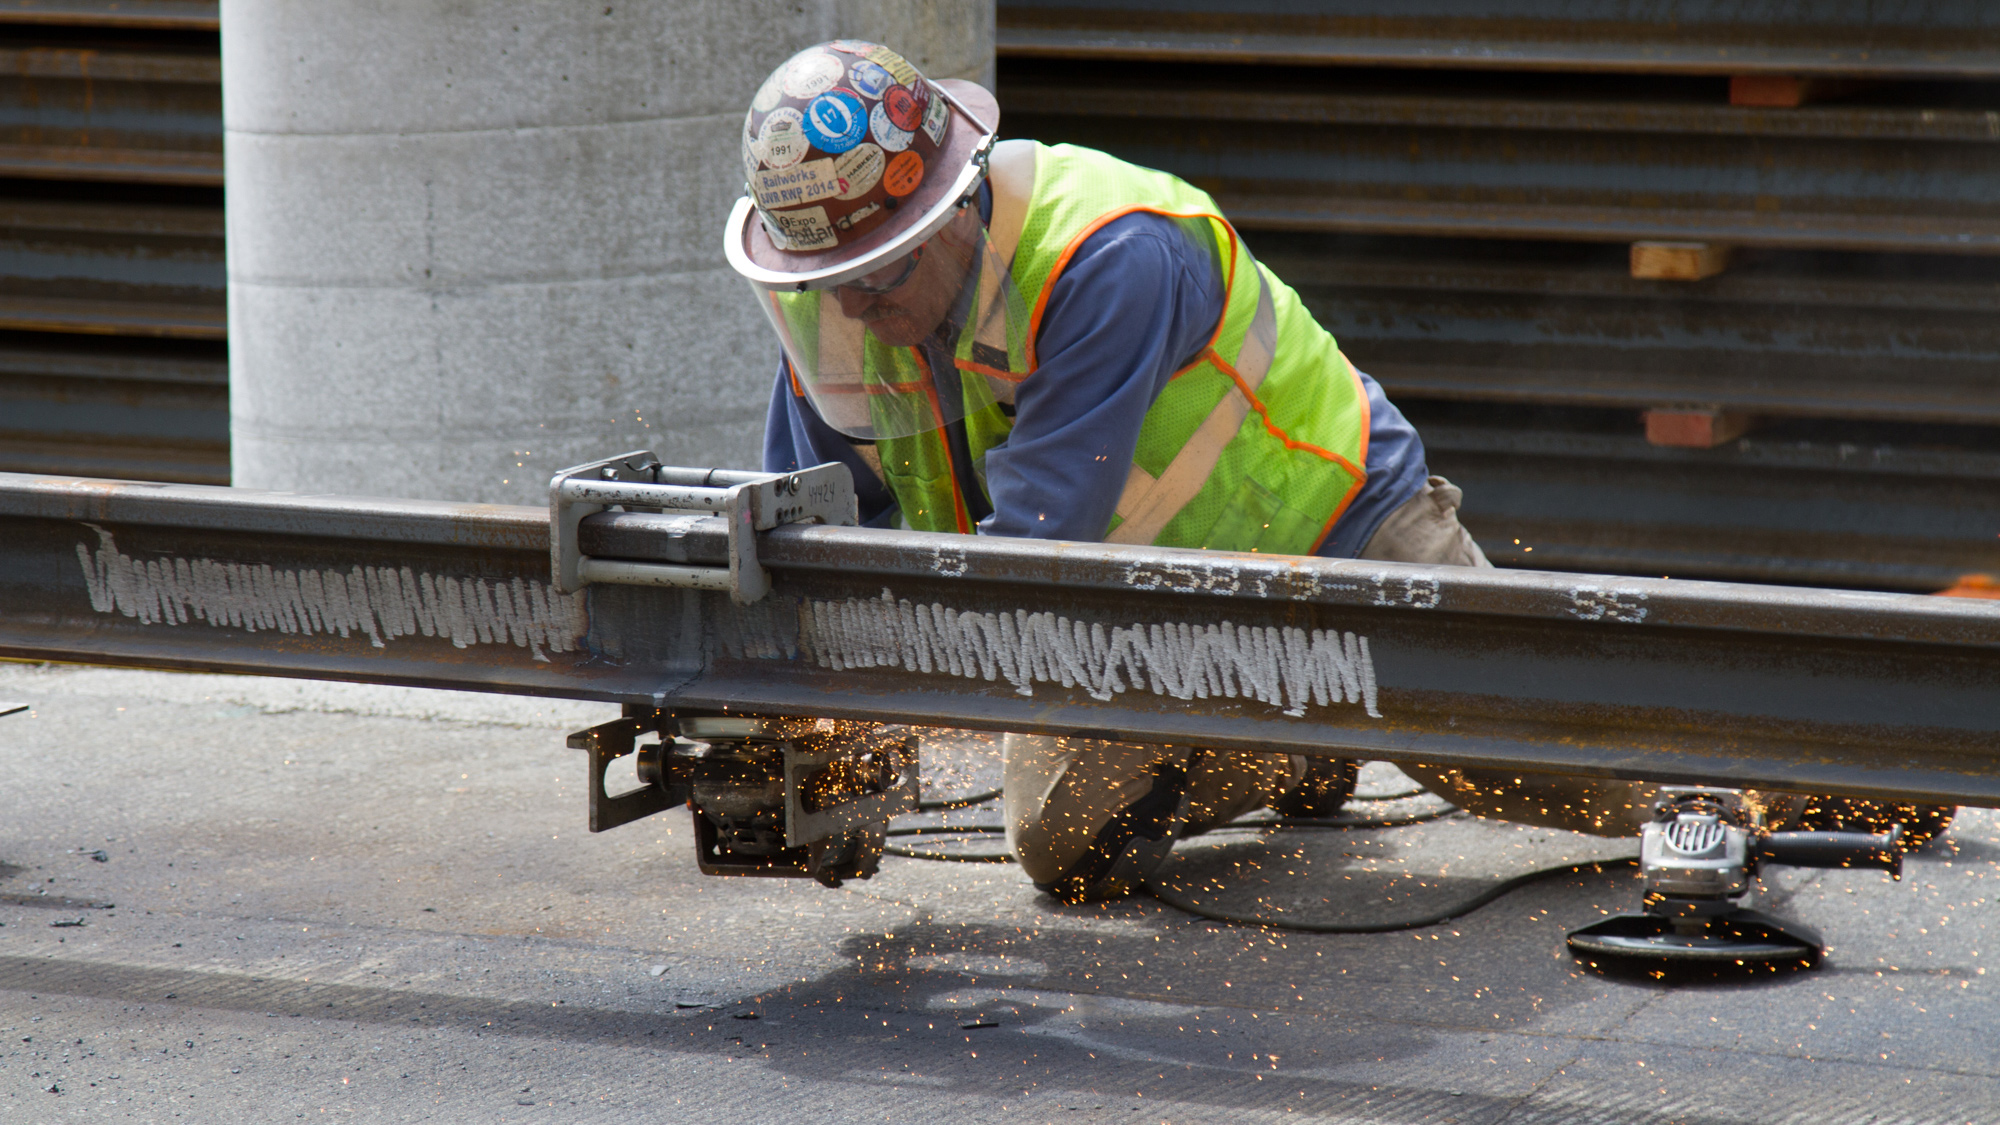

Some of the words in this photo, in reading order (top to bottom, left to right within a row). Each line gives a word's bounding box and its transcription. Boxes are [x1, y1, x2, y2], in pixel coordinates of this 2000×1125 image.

[806, 75, 830, 90] 1991
[822, 108, 838, 124] 17
[771, 144, 792, 156] 1991
[846, 150, 878, 178] HASKELL
[763, 170, 817, 188] Railworks
[781, 187, 803, 201] RWP
[806, 180, 835, 197] 2014
[790, 217, 817, 227] Expo
